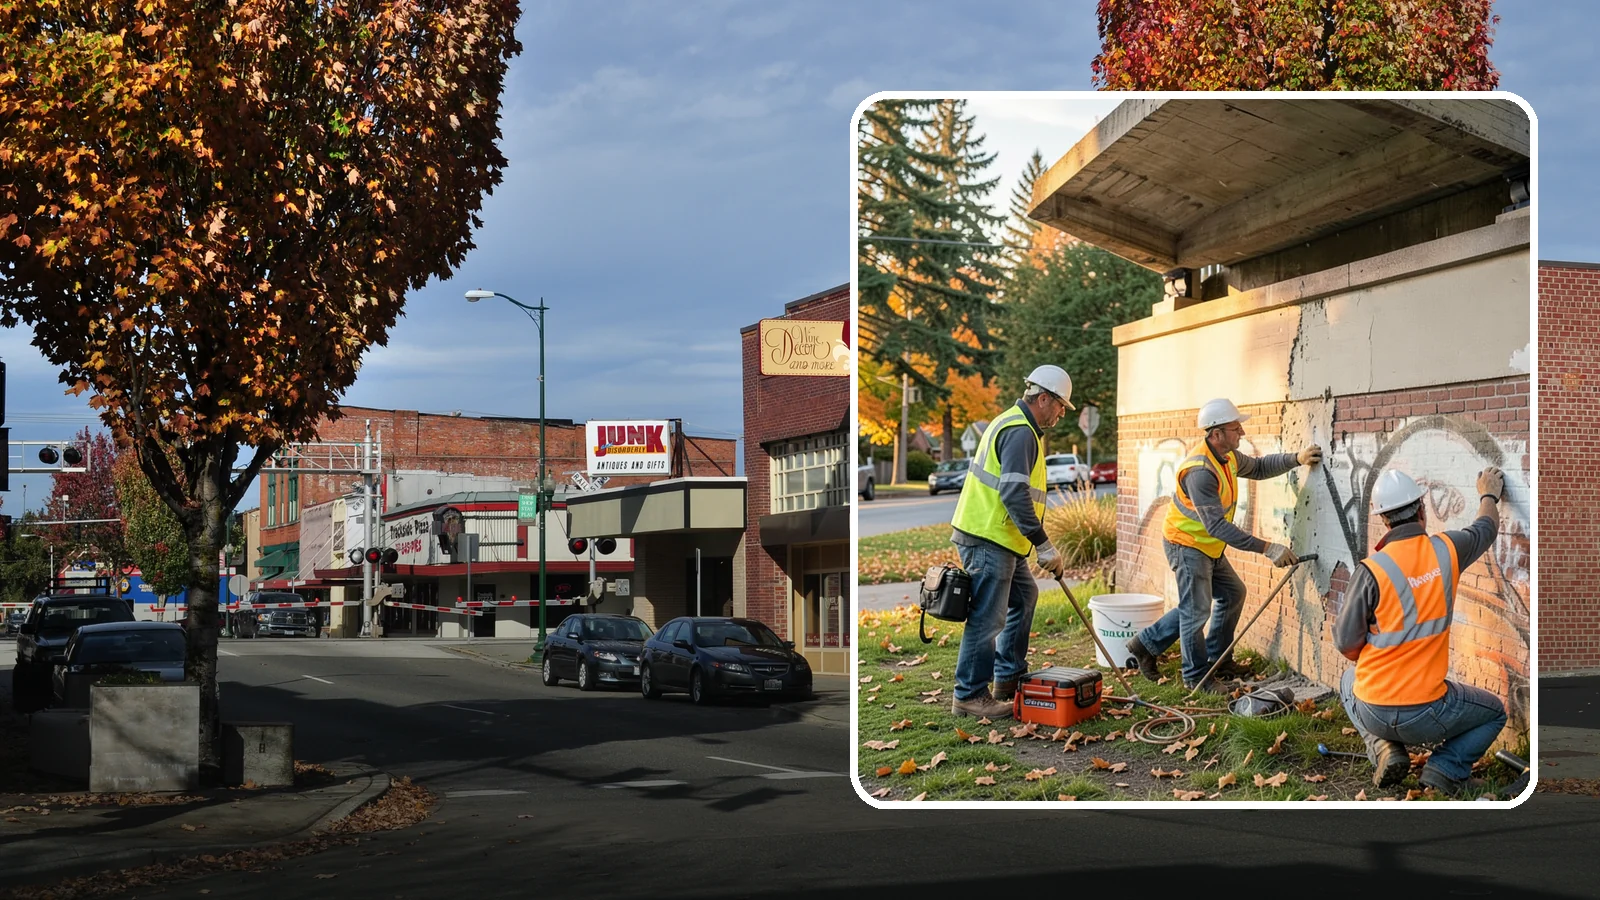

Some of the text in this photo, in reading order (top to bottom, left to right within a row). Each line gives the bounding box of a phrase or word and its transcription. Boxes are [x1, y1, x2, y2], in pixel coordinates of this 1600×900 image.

[596, 425, 665, 457] JUNK
[607, 446, 646, 454] DISORDERLY
[597, 460, 666, 470] ANTIQUES AND GIFTS
[390, 519, 429, 540] Trackside Pizza
